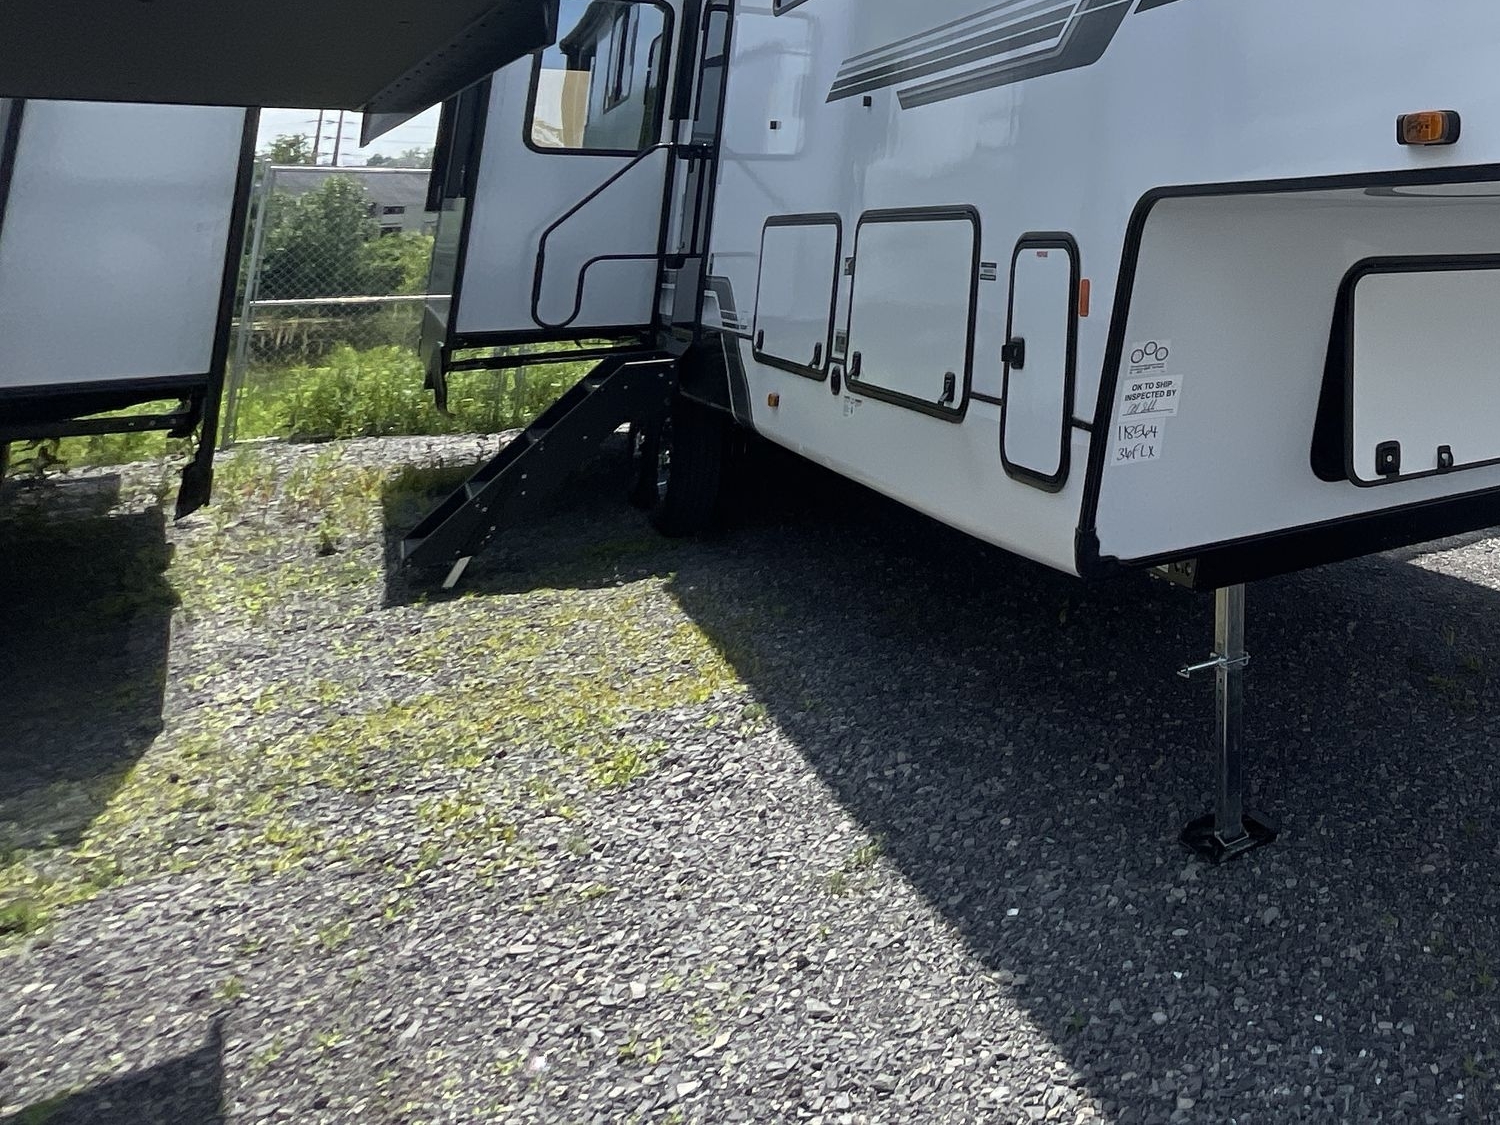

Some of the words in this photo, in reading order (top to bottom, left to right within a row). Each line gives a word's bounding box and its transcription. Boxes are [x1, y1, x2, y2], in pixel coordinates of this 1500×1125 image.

[1131, 383, 1143, 391] OK
[1145, 382, 1154, 390] TO
[1155, 380, 1173, 389] SHIP
[1124, 390, 1165, 401] INSPECTED
[1166, 389, 1177, 397] BY
